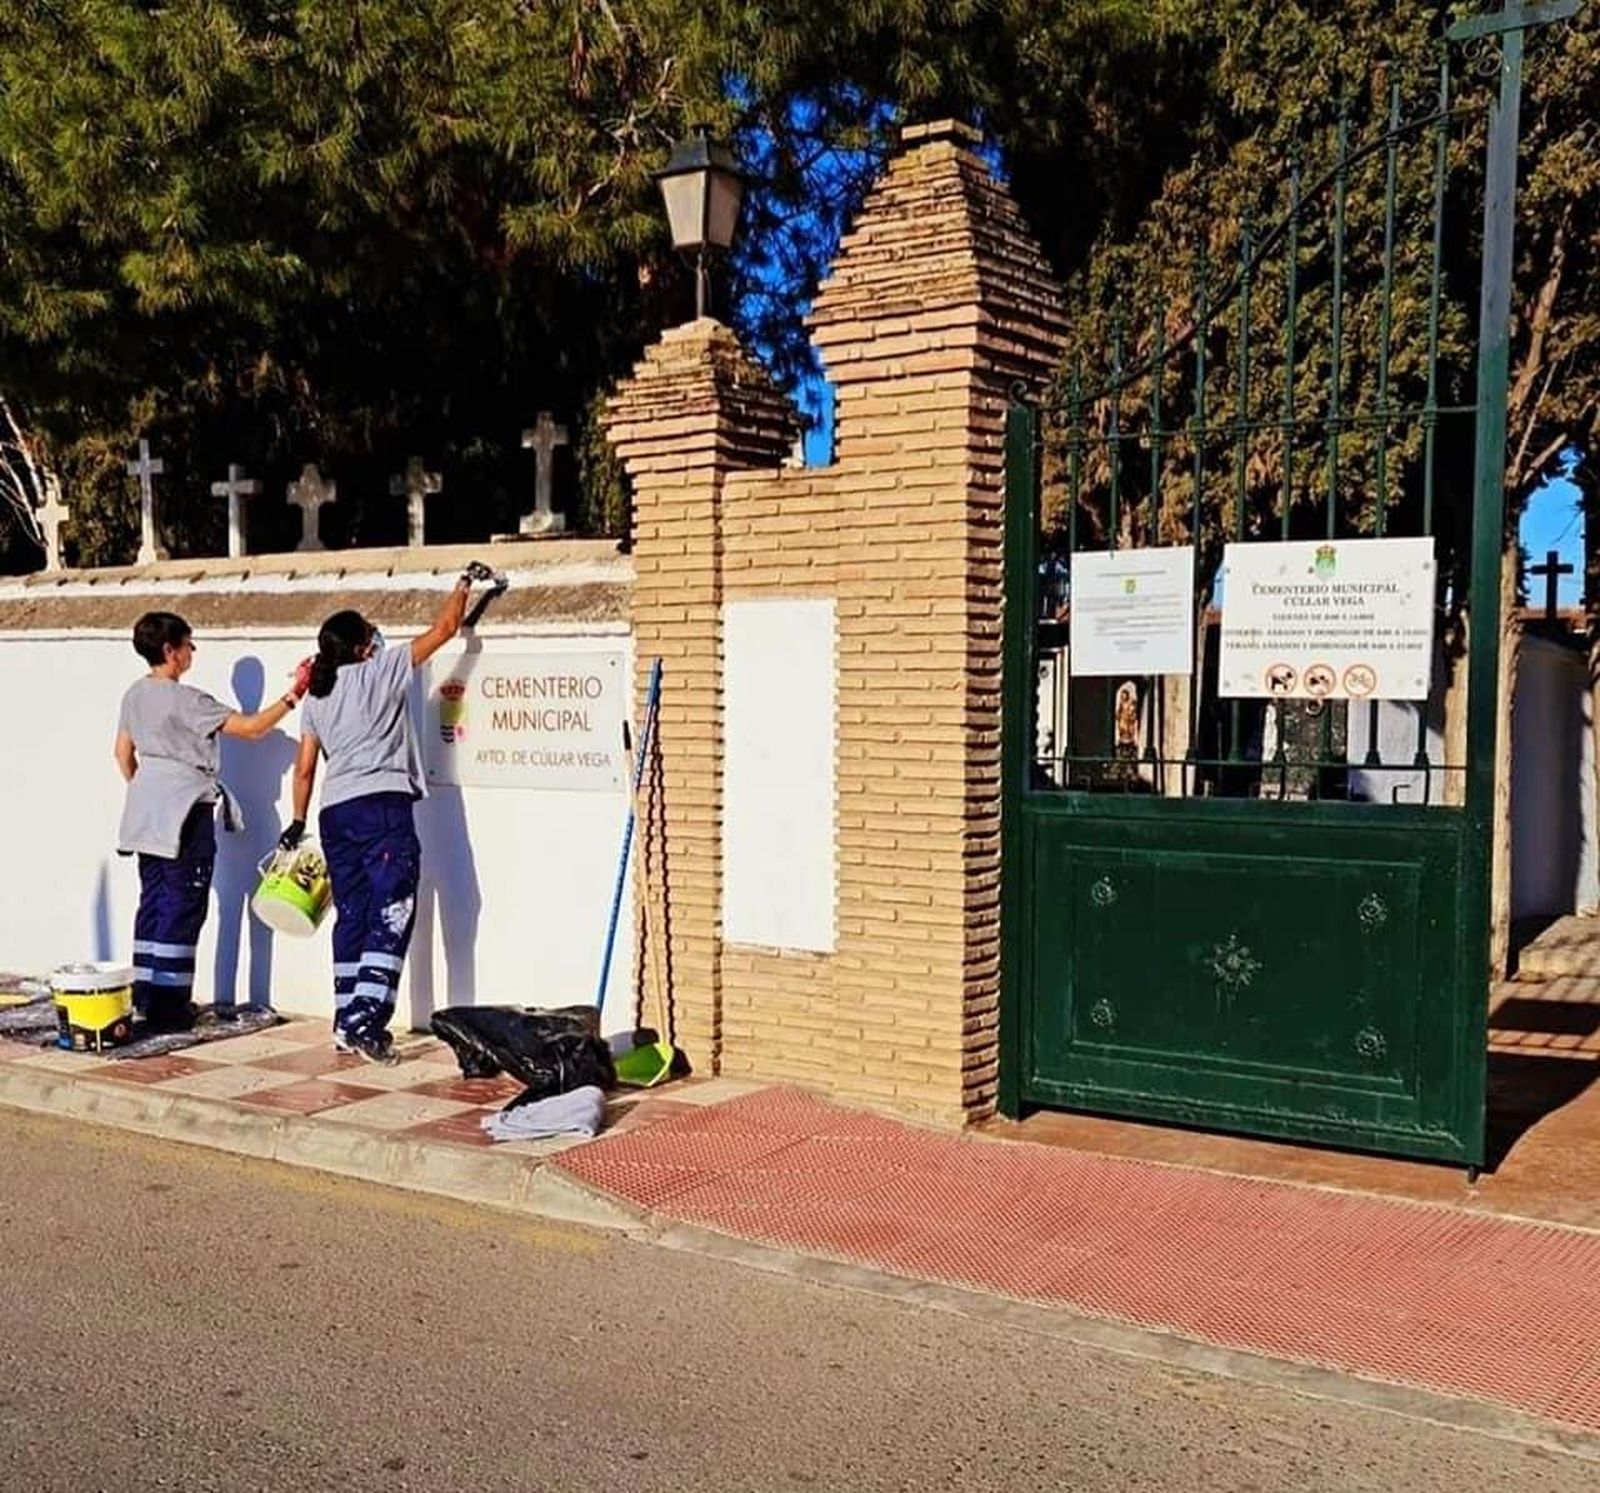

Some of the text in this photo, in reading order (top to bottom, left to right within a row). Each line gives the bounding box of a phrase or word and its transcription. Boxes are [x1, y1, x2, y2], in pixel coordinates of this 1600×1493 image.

[1252, 583, 1399, 595] CEMENTERIO MUNICIPAL
[1333, 596, 1365, 606] VEGA
[481, 676, 603, 699] CEMENTERIO
[492, 708, 593, 732] MUNICIPAL
[511, 750, 527, 765] DE
[577, 751, 612, 768] VEGA
